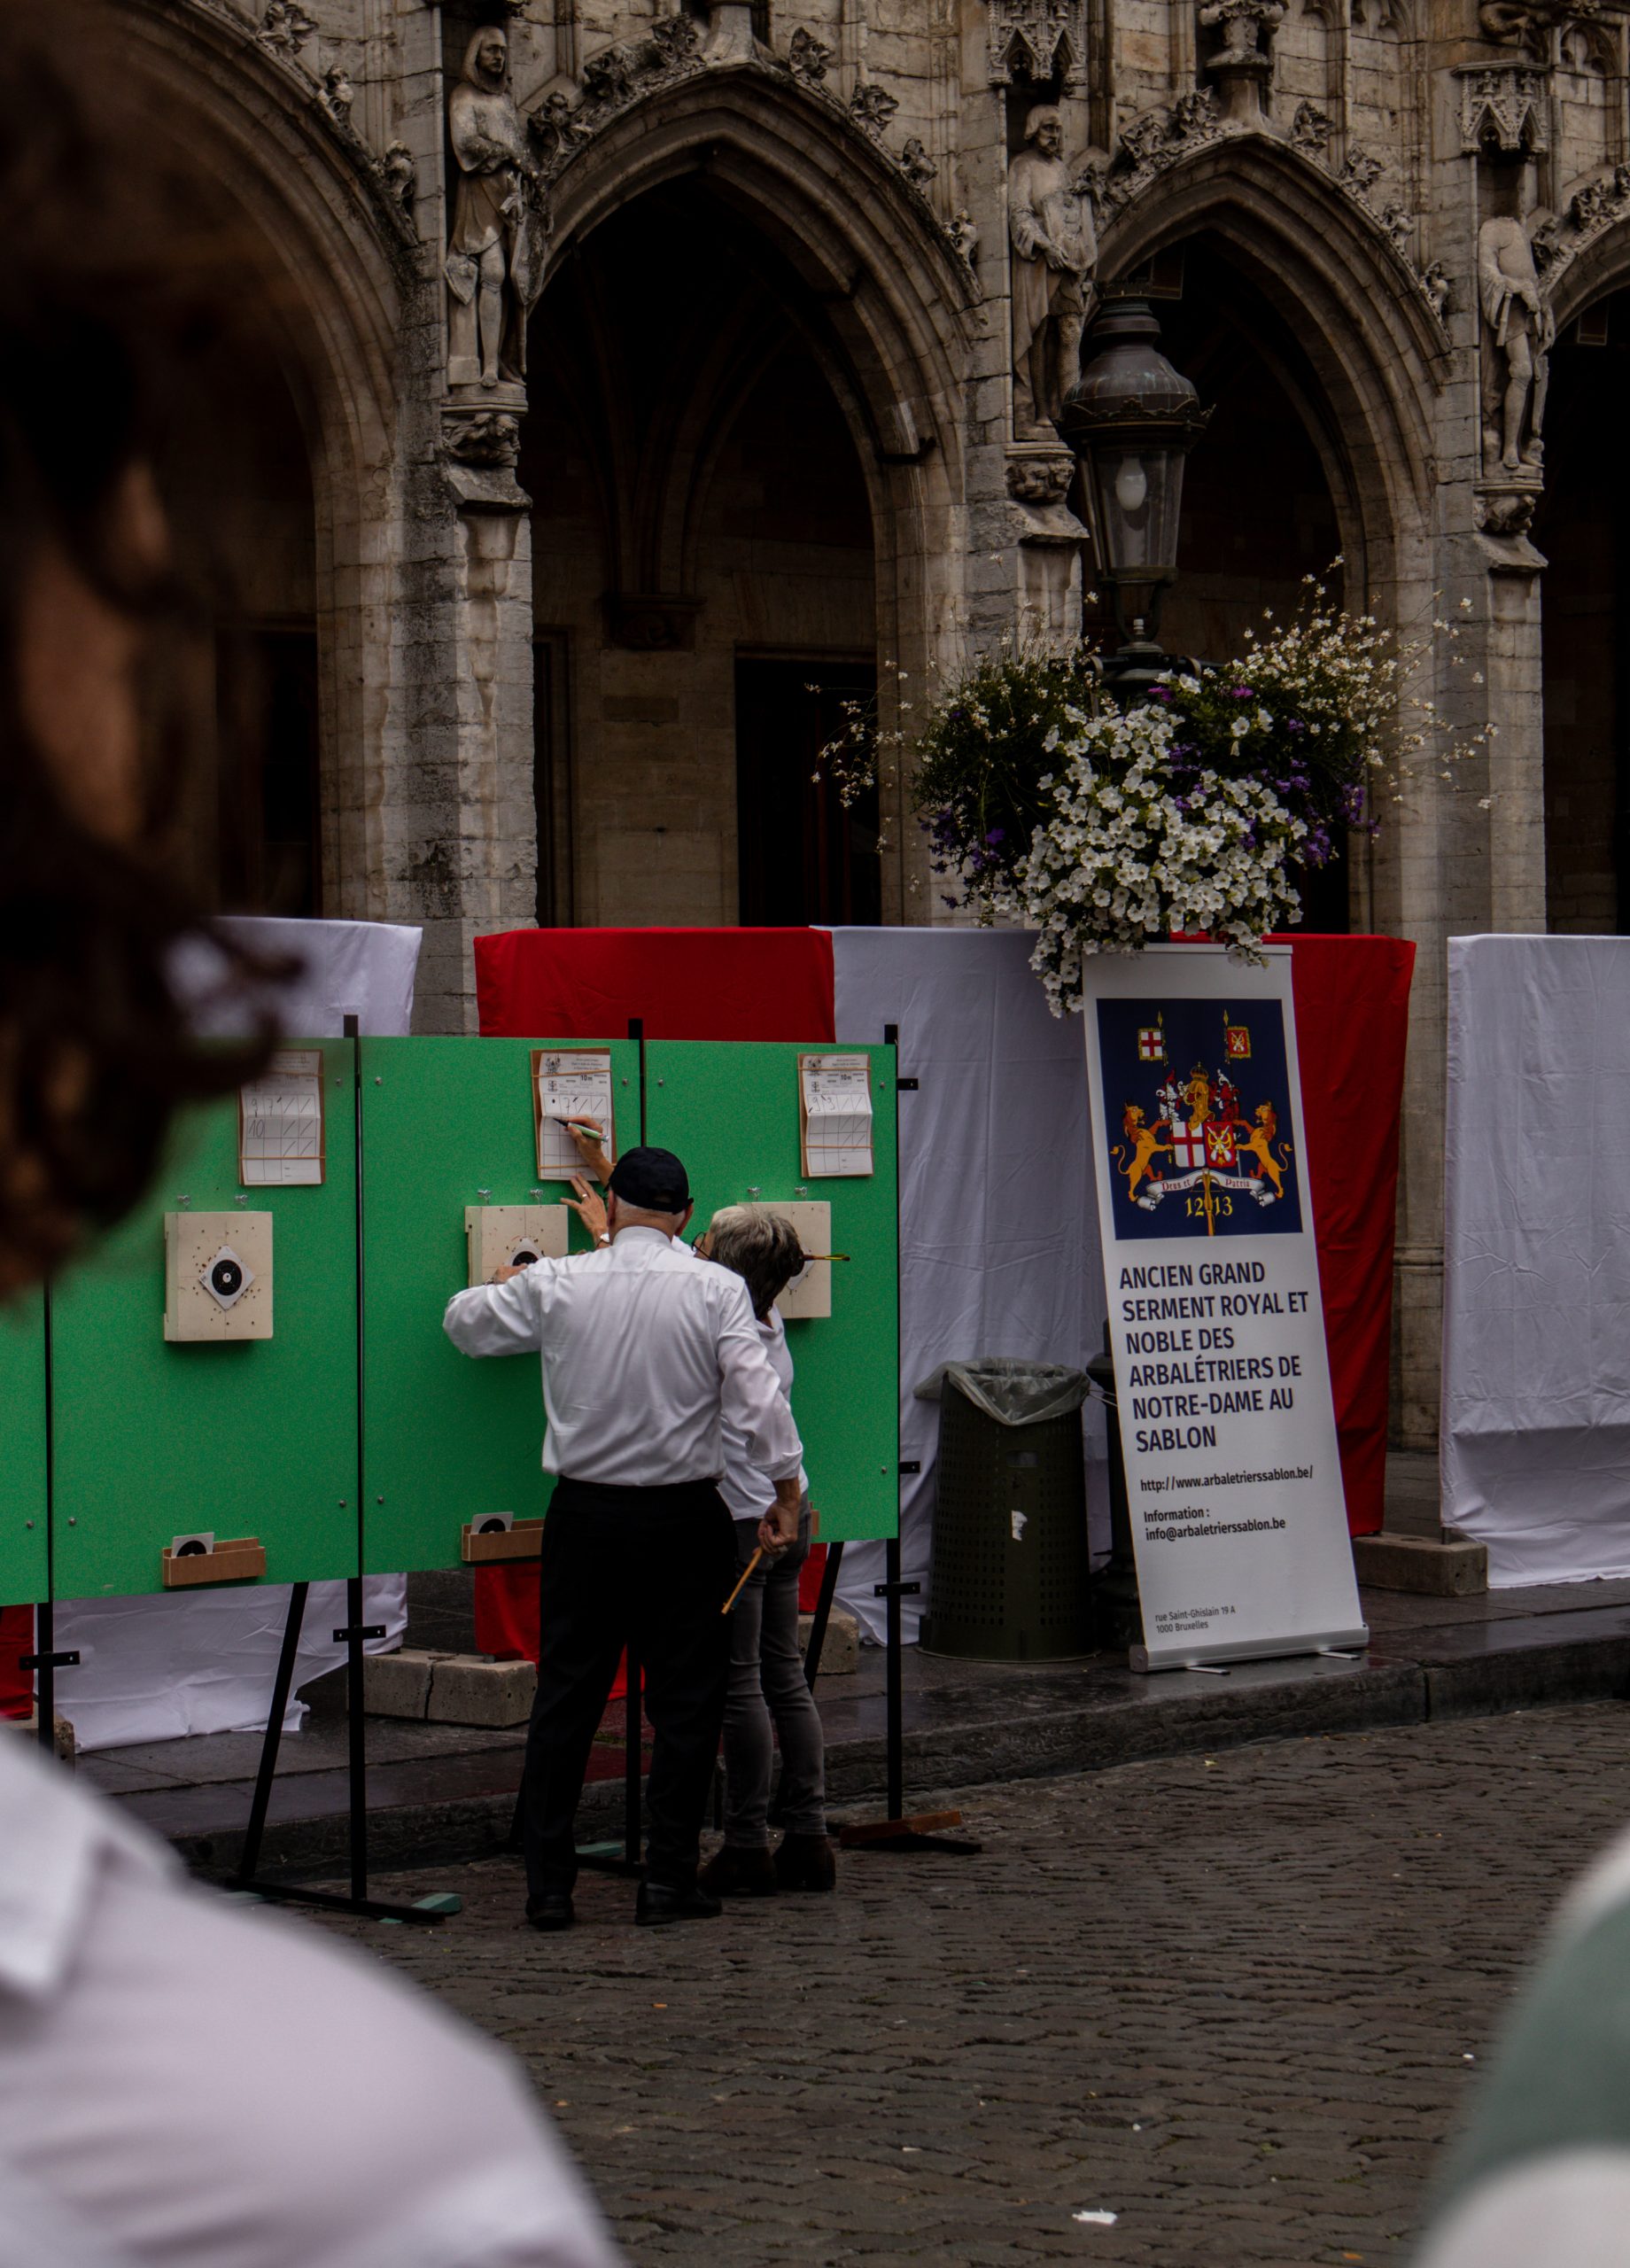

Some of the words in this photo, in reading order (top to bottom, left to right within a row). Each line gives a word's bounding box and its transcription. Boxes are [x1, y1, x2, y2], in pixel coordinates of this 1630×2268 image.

[1183, 1178, 1191, 1187] et
[1225, 1177, 1250, 1188] Patria
[1120, 1264, 1193, 1289] ANCIEN
[1199, 1262, 1265, 1285] GRAND
[1122, 1295, 1215, 1322] SERMENT
[1220, 1293, 1284, 1317] ROYAL
[1288, 1291, 1308, 1313] ET
[1126, 1330, 1193, 1354] NOBLE
[1199, 1327, 1234, 1350] DES
[1129, 1354, 1274, 1387] ARBALÉTRIERS
[1278, 1355, 1301, 1377] DE
[1132, 1389, 1264, 1419] NOTRE-DAME
[1269, 1387, 1293, 1410] AU
[1136, 1425, 1216, 1452] SABLON
[1140, 1464, 1313, 1493] http://www.arbaletrierssablon.be/
[1144, 1506, 1204, 1523] Information
[1145, 1517, 1286, 1542] info@arbaletrierssablon.be
[1155, 1612, 1168, 1622] rue
[1168, 1606, 1220, 1621] Saint-Ghislain
[1221, 1605, 1230, 1616] 19
[1230, 1605, 1236, 1614] A
[1156, 1623, 1174, 1634] 1000
[1175, 1619, 1209, 1632] Bruxelles
